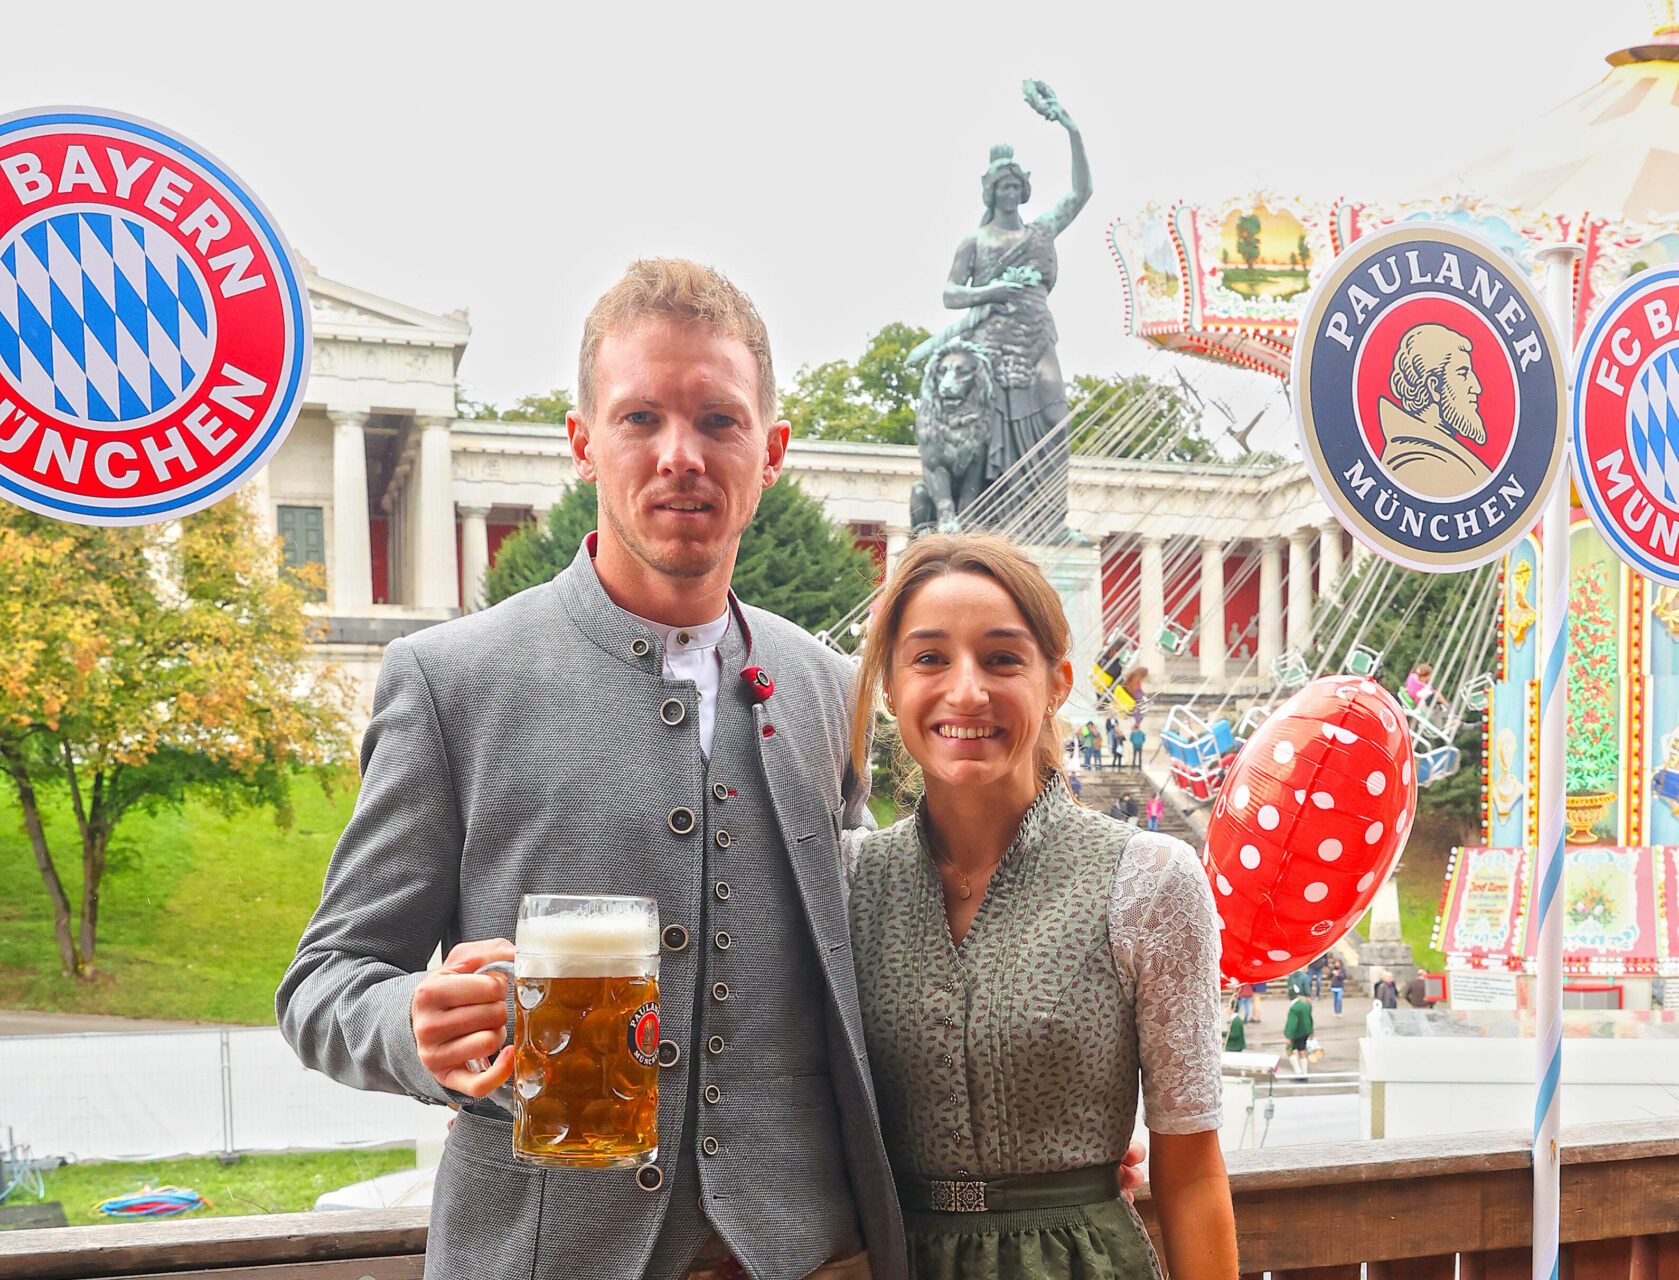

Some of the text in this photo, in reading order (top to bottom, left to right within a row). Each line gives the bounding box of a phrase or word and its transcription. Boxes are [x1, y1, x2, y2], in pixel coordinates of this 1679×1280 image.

[0, 145, 267, 299] BAYERN
[1325, 250, 1543, 373] PAULANER
[1595, 326, 1642, 397] FC
[0, 362, 268, 490] ÜNCHEN
[1343, 459, 1527, 542] MÜNCHEN
